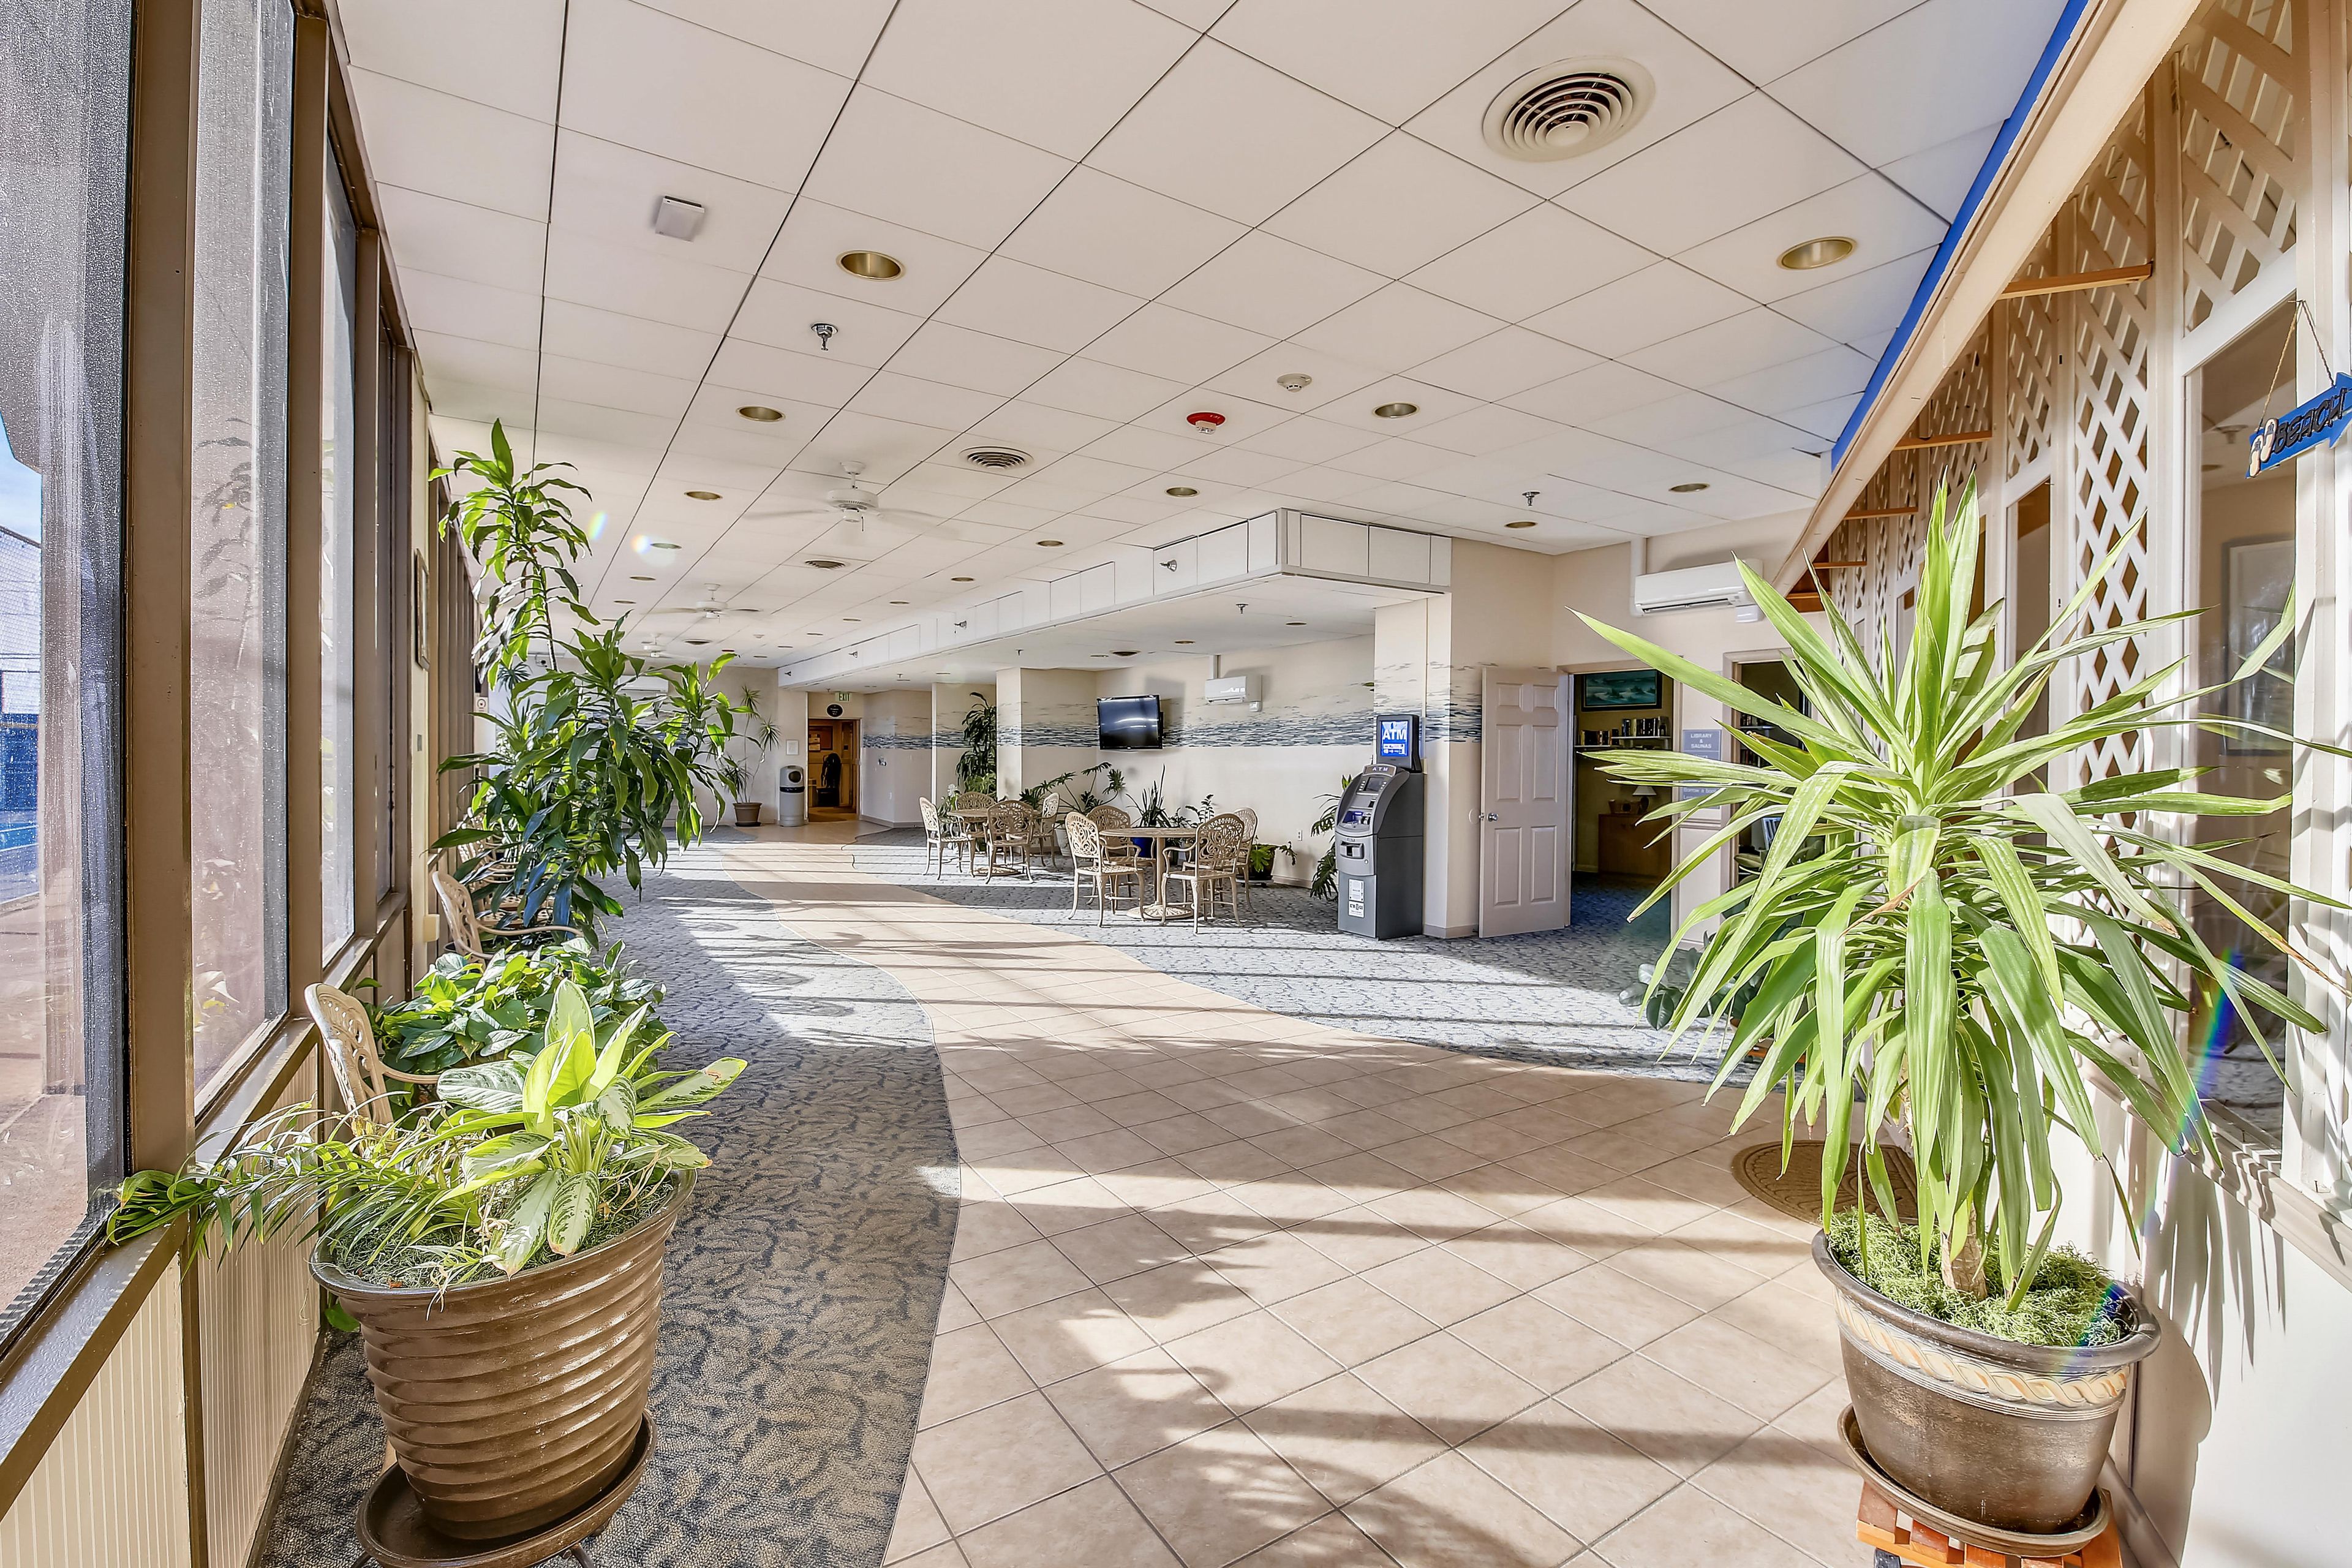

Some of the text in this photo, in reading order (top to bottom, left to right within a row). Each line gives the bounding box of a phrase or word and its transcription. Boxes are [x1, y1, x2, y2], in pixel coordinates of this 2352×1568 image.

[2274, 388, 2347, 453] BEACH
[839, 693, 850, 701] EXIT
[1382, 729, 1406, 740] ATM
